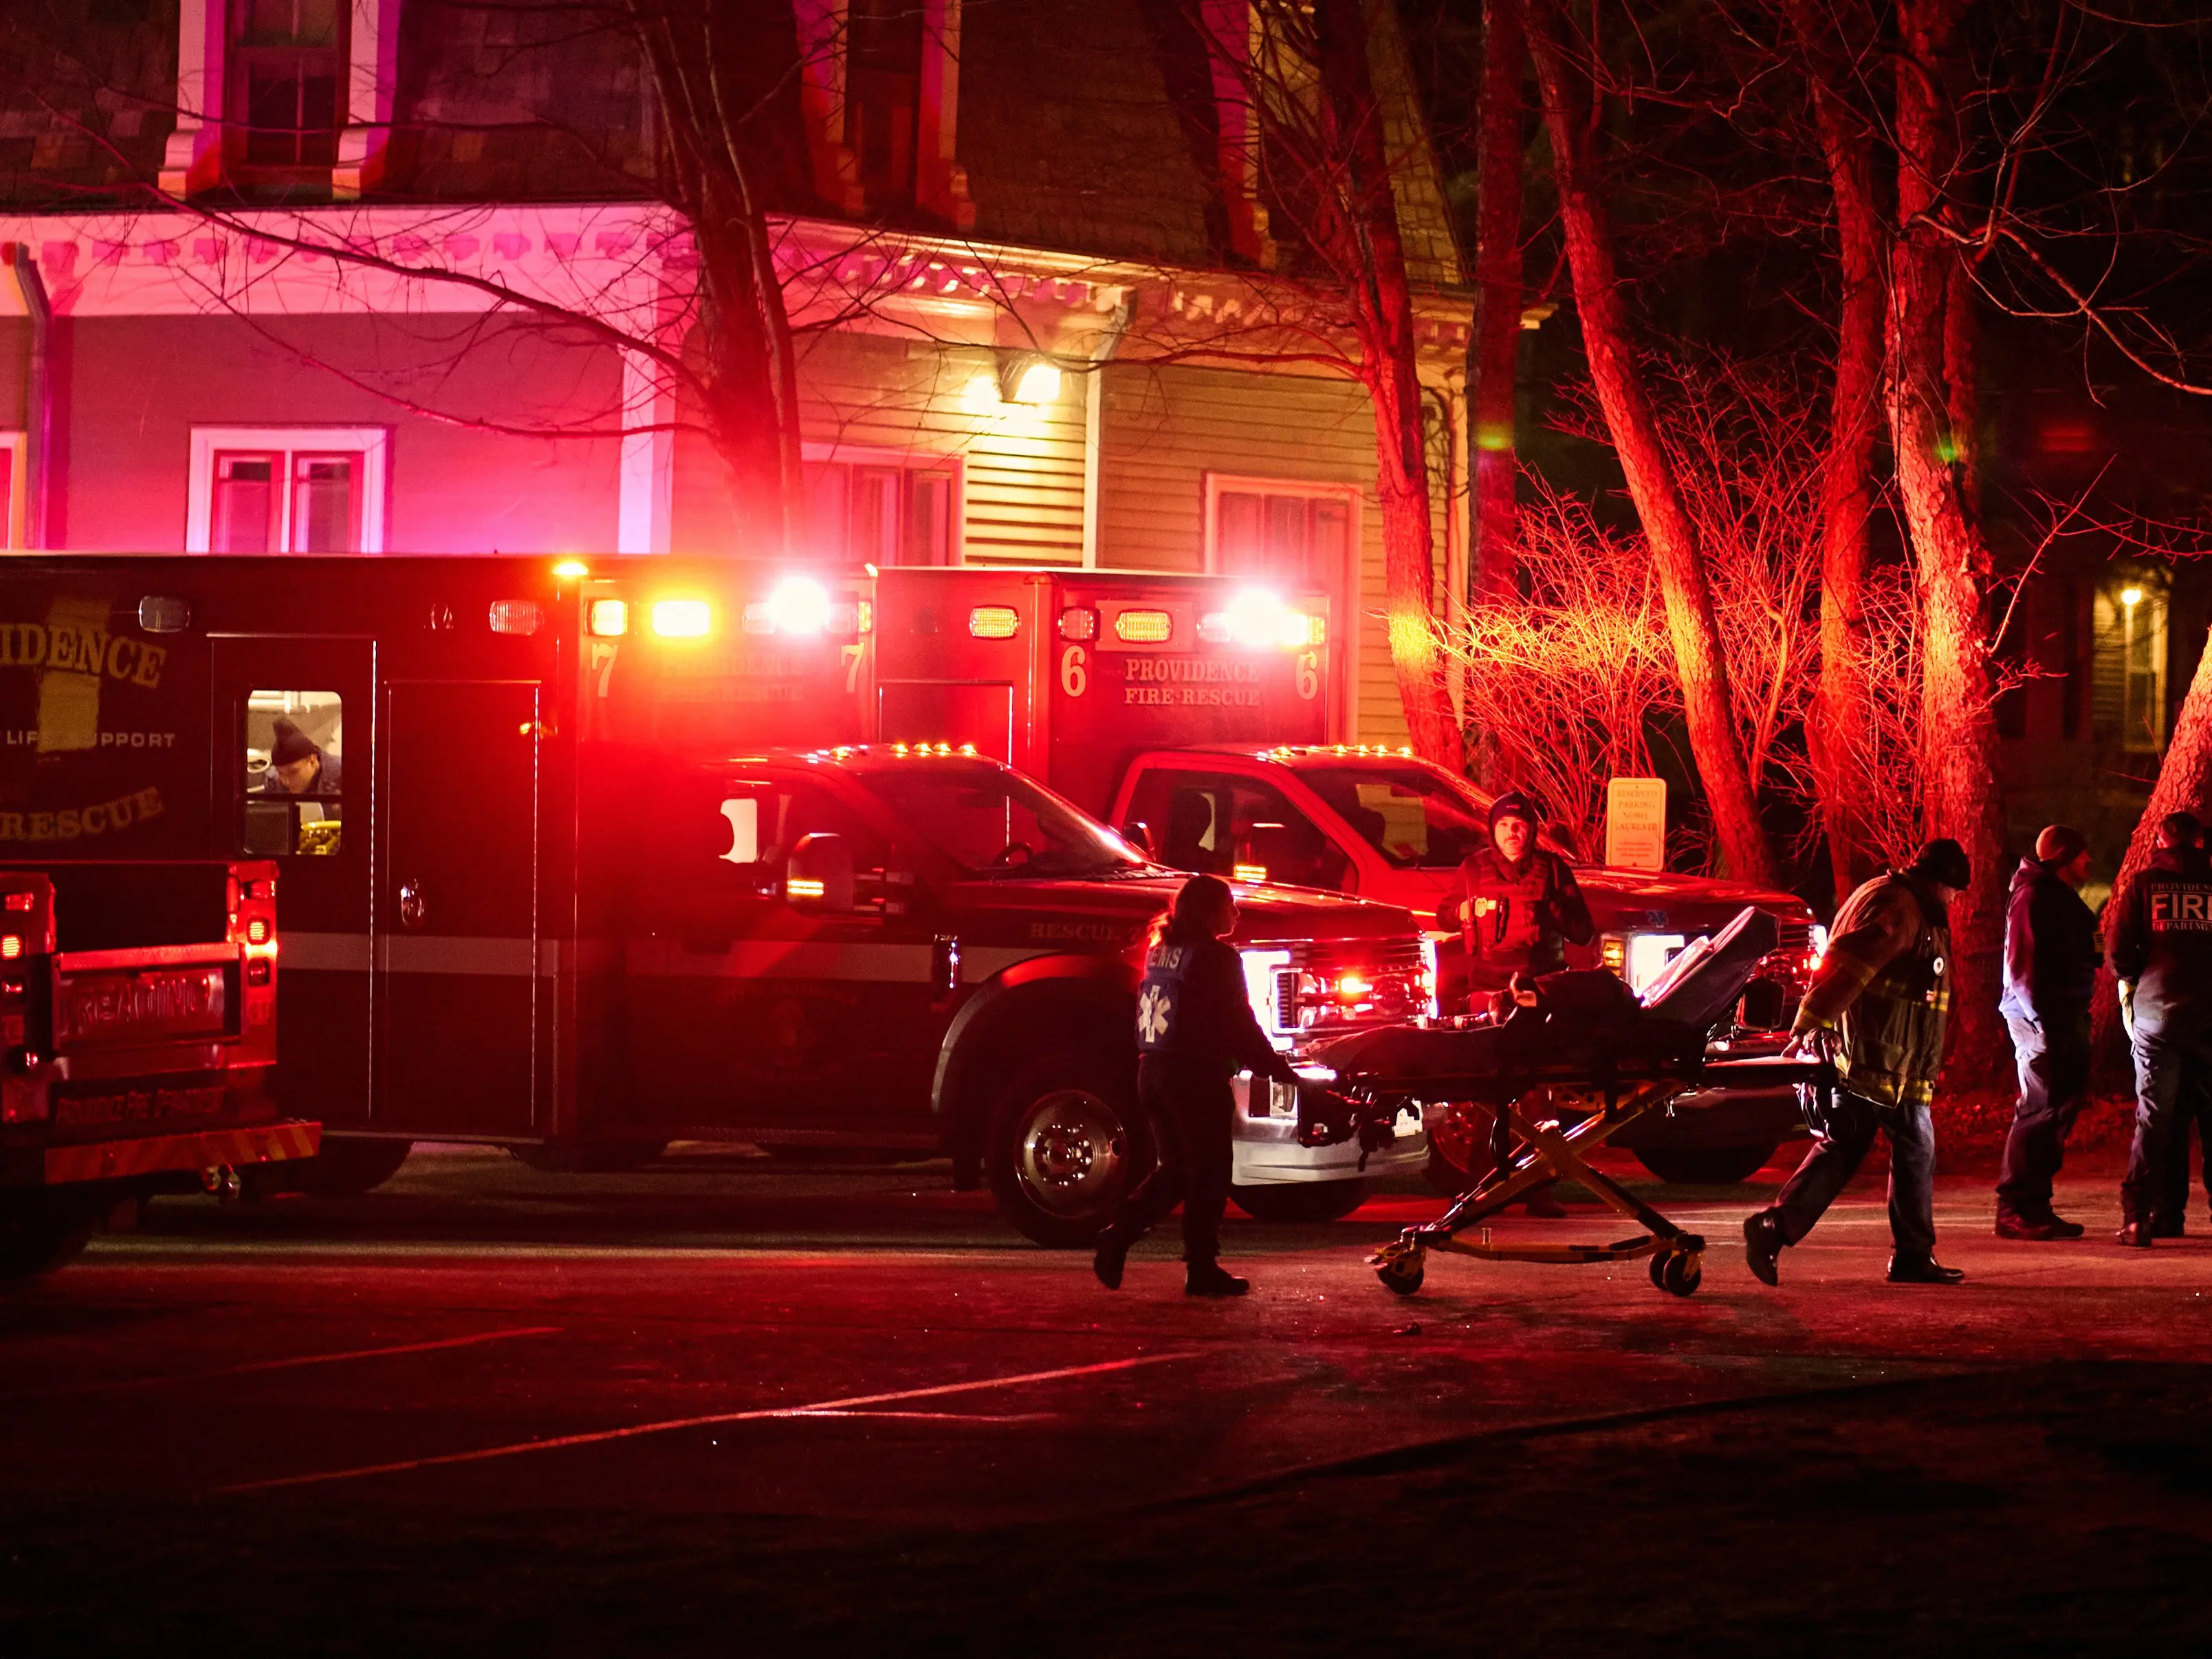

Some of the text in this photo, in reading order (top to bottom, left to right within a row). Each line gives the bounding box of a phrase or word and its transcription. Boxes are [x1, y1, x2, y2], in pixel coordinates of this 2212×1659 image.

[592, 643, 618, 698] 7
[840, 642, 864, 694] 7
[1061, 645, 1086, 697] 6
[1125, 658, 1260, 683] PROVIDENCE
[1295, 651, 1319, 700] 6
[1124, 688, 1260, 705] FIRE RESCUE
[7, 730, 176, 747] LIF PPORT
[1616, 789, 1657, 798] RESERVED
[1615, 822, 1657, 831] LAUREATE
[2150, 882, 2212, 892] PROVIDEN
[1148, 945, 1183, 969] EMS
